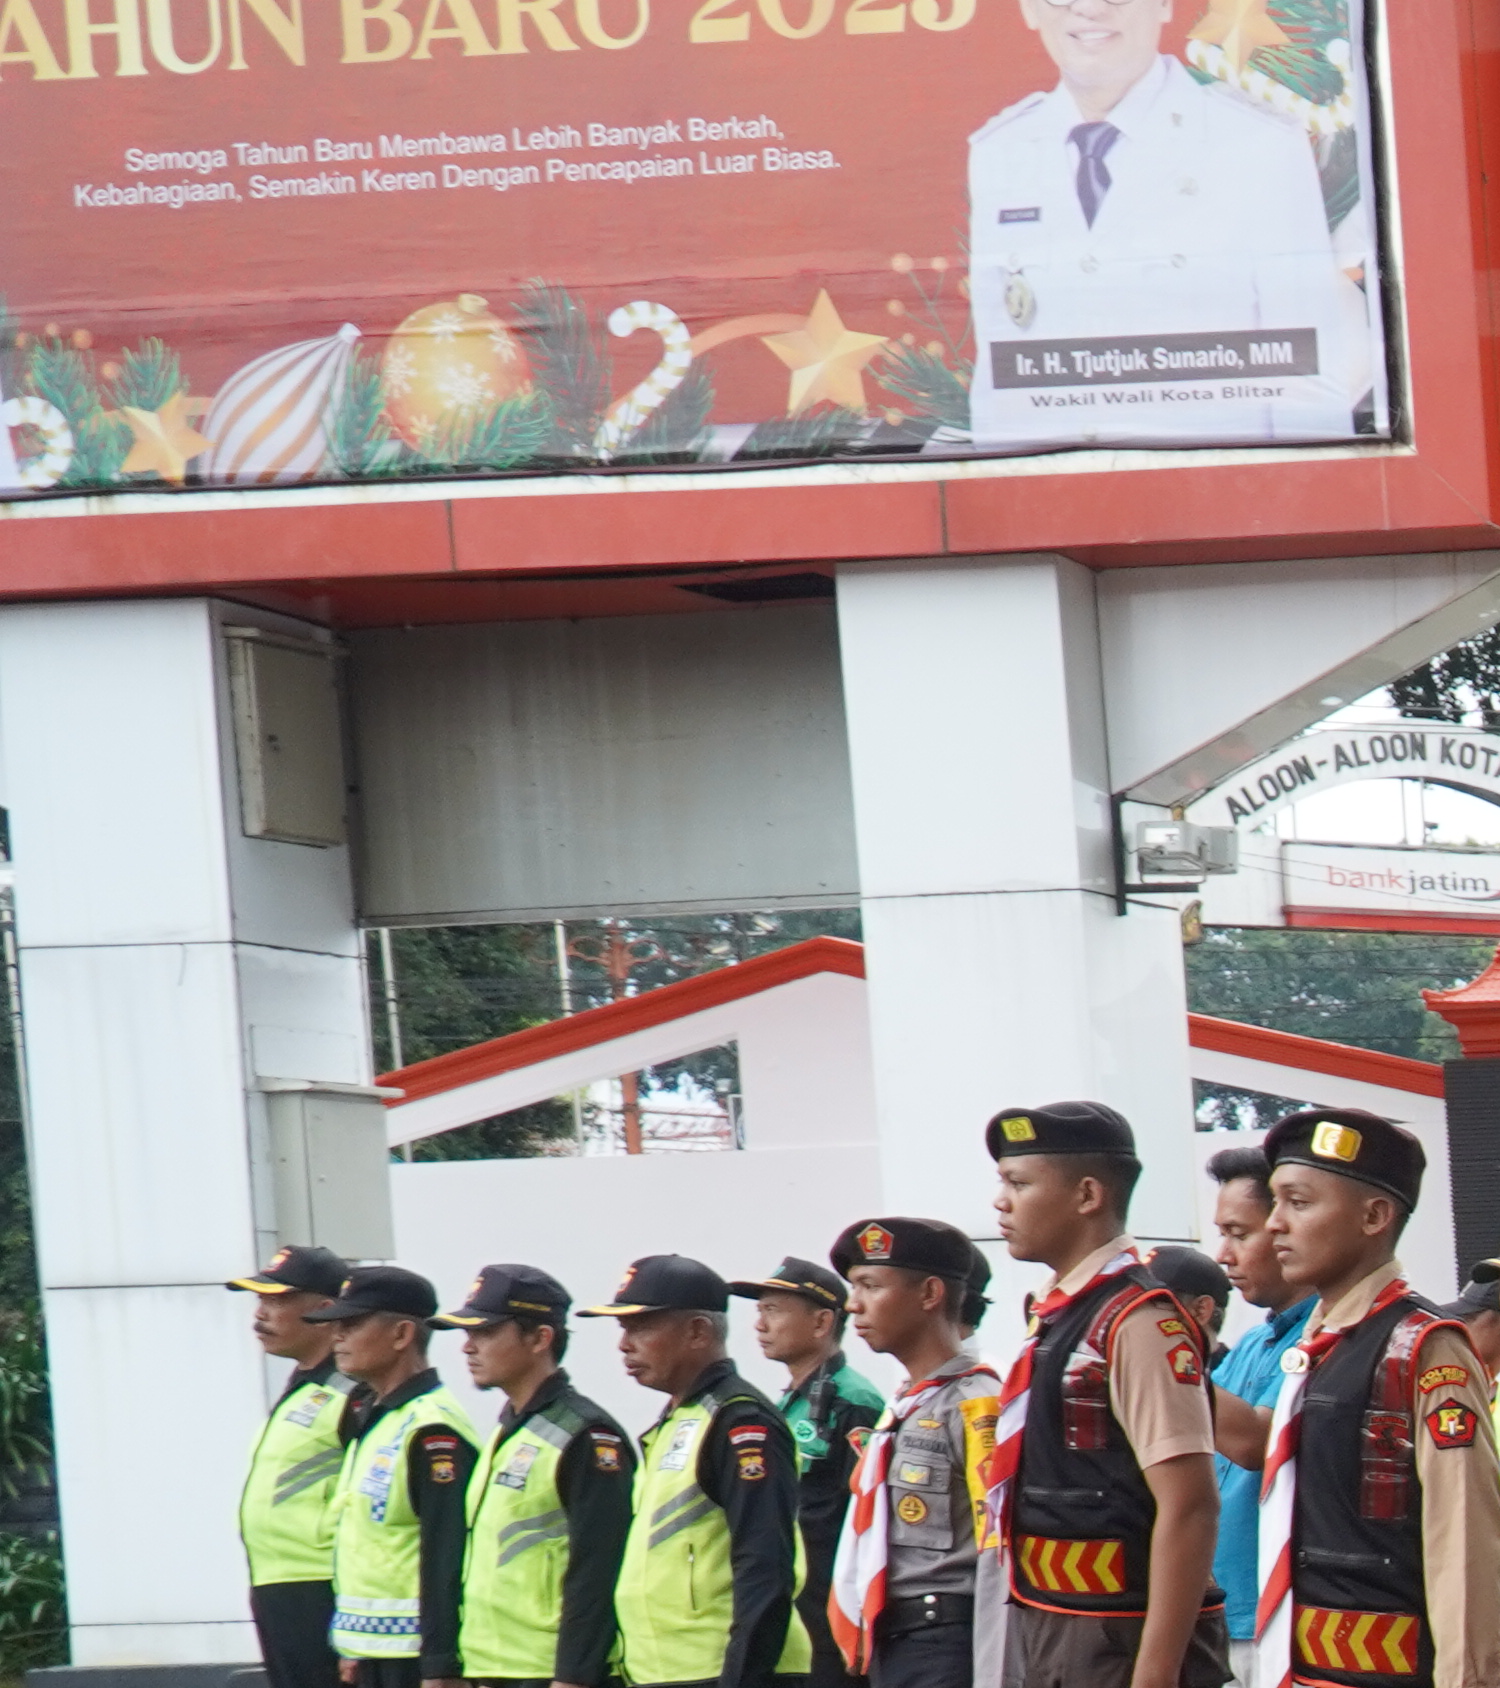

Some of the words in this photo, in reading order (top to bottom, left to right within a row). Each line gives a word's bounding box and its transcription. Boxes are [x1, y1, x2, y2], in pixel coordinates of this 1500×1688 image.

[124, 146, 228, 175] Semoga
[232, 141, 308, 167] Tahun
[313, 135, 374, 163] Baru
[379, 130, 507, 160] Membawa
[513, 124, 582, 152] Lebih
[587, 118, 684, 151] Banyak
[688, 113, 785, 142] Berkah,
[74, 178, 243, 209] Kebahagiaan,
[248, 169, 356, 201] Semakin
[361, 167, 437, 193] Keren
[442, 161, 540, 192] Dengan
[546, 154, 694, 184] Pencapaian
[699, 150, 758, 177] Luar
[763, 147, 842, 173] Biasa.
[1015, 354, 1039, 377] Ir.
[1043, 352, 1068, 375] H.
[1071, 348, 1150, 379] Tjutjuk
[1153, 345, 1246, 371] Sunario,
[1248, 341, 1294, 366] MM
[1030, 391, 1096, 408] Wakil
[1101, 389, 1154, 405] Wali
[1160, 388, 1215, 403] Kota
[1221, 384, 1286, 400] Blitar
[1224, 734, 1428, 825] ALOON-ALOON
[1326, 865, 1491, 894] bankjatim
